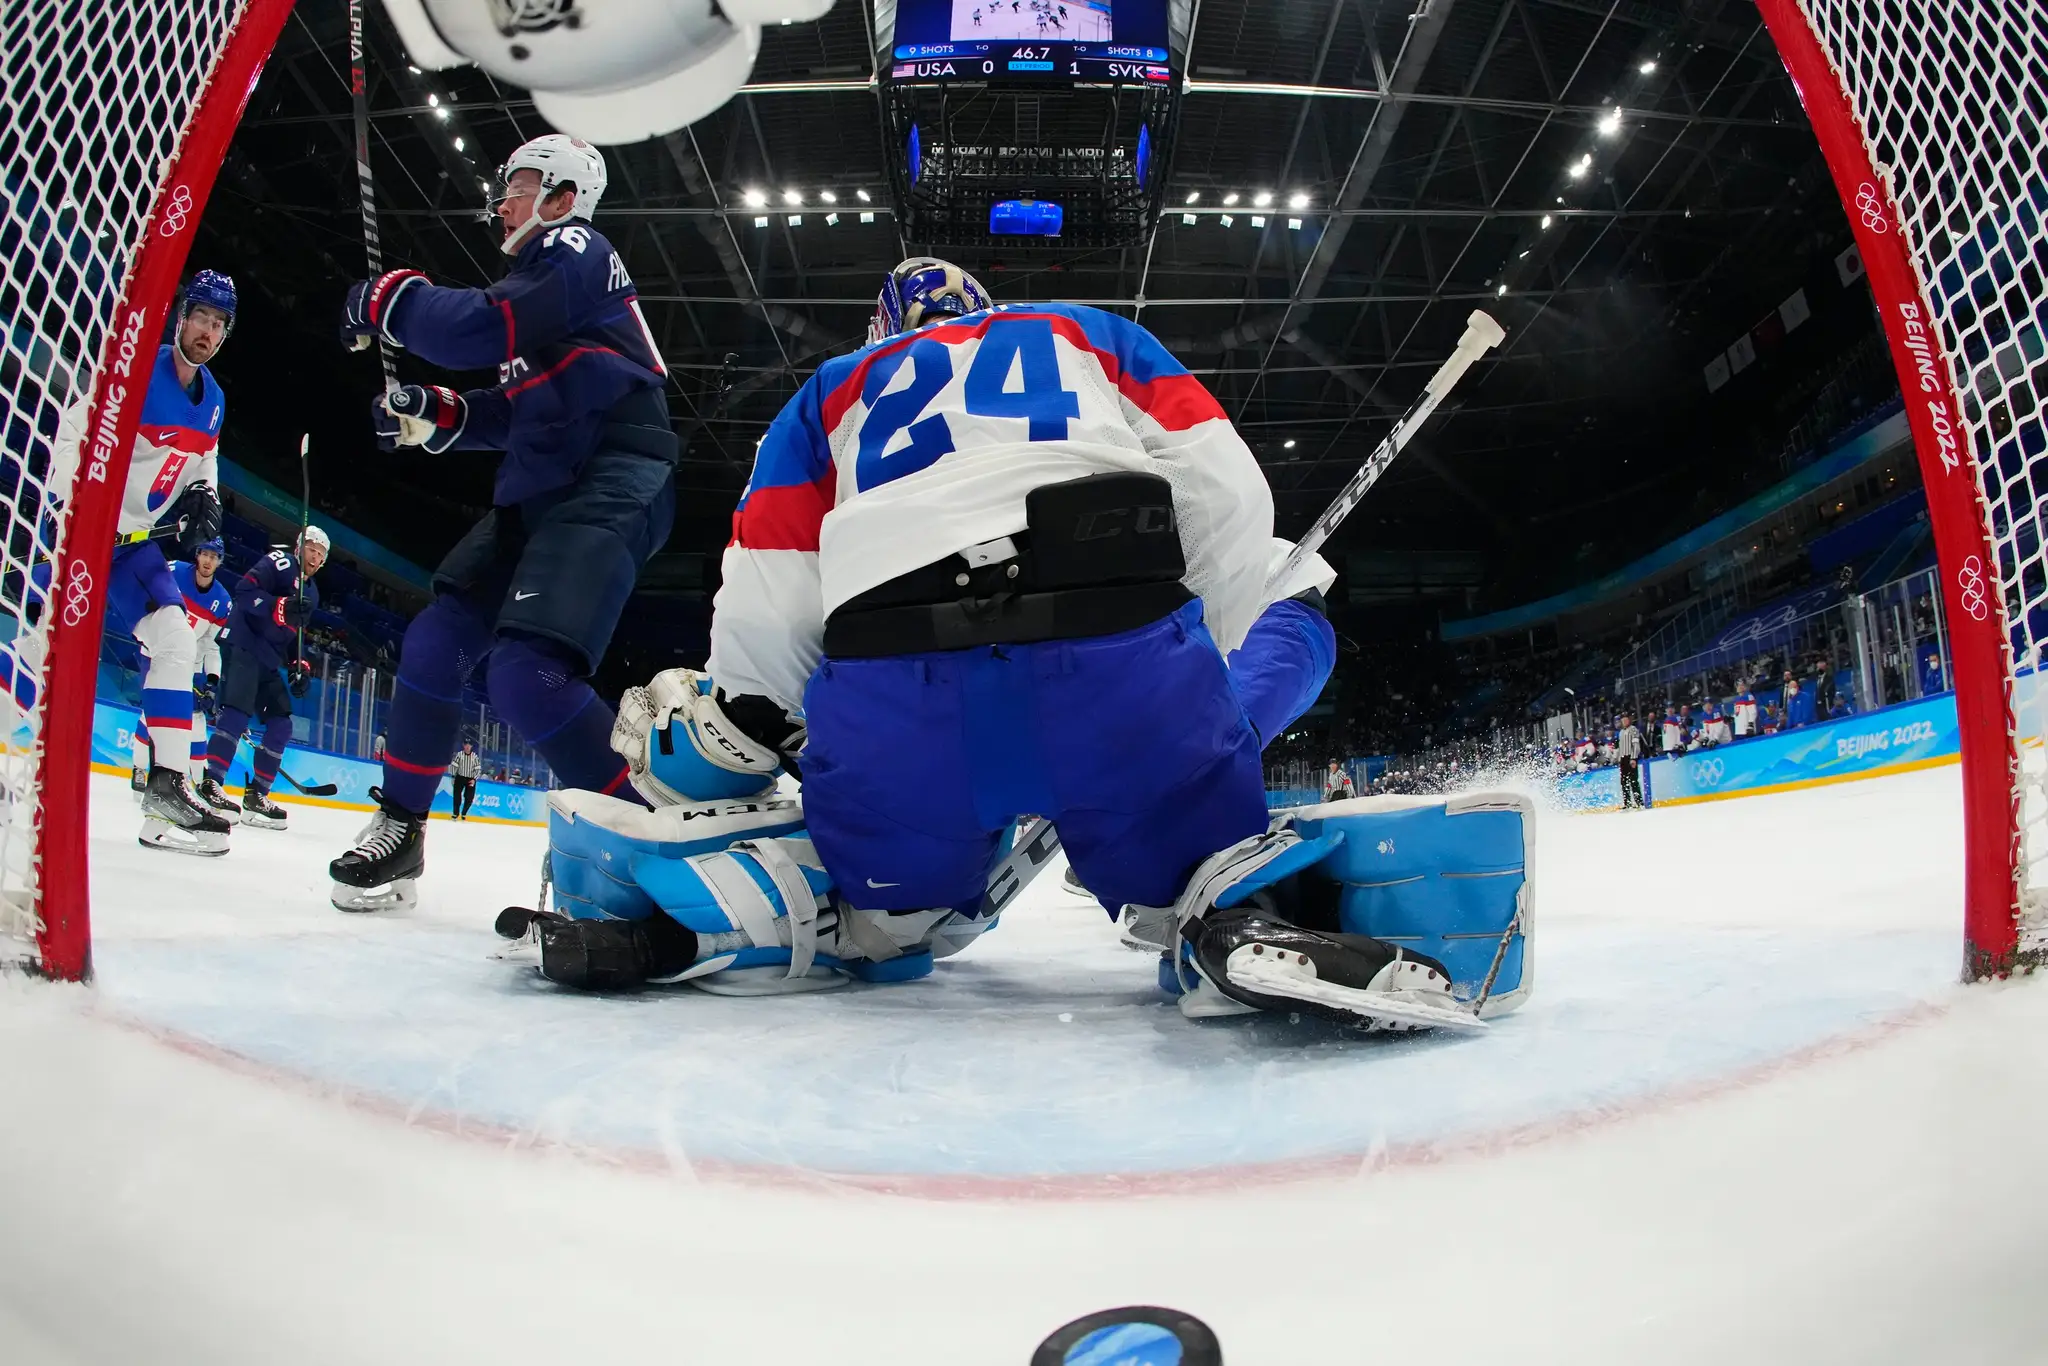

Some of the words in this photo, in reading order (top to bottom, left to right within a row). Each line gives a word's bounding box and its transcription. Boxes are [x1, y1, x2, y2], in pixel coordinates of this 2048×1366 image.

[909, 47, 917, 55] 9
[921, 45, 954, 55] SHOTS
[1012, 47, 1050, 59] 46.7
[1108, 47, 1141, 56] SHOTS
[1146, 49, 1153, 58] 8
[918, 62, 956, 77] USA
[982, 60, 994, 74] 0
[1069, 62, 1080, 75] 1
[1109, 63, 1145, 78] SVK
[88, 383, 127, 484] BEIJING
[114, 306, 147, 379] 2022
[1899, 300, 1941, 393] BEIJING
[1927, 400, 1960, 477] 2022
[855, 318, 1081, 494] 24
[208, 404, 221, 430] A
[1320, 439, 1398, 537] CCM
[267, 549, 291, 572] 20
[1290, 556, 1304, 572] PRO
[210, 599, 220, 613] A
[704, 720, 756, 764] CCM
[1836, 730, 1890, 759] BEIJING
[1892, 720, 1938, 746] 2022
